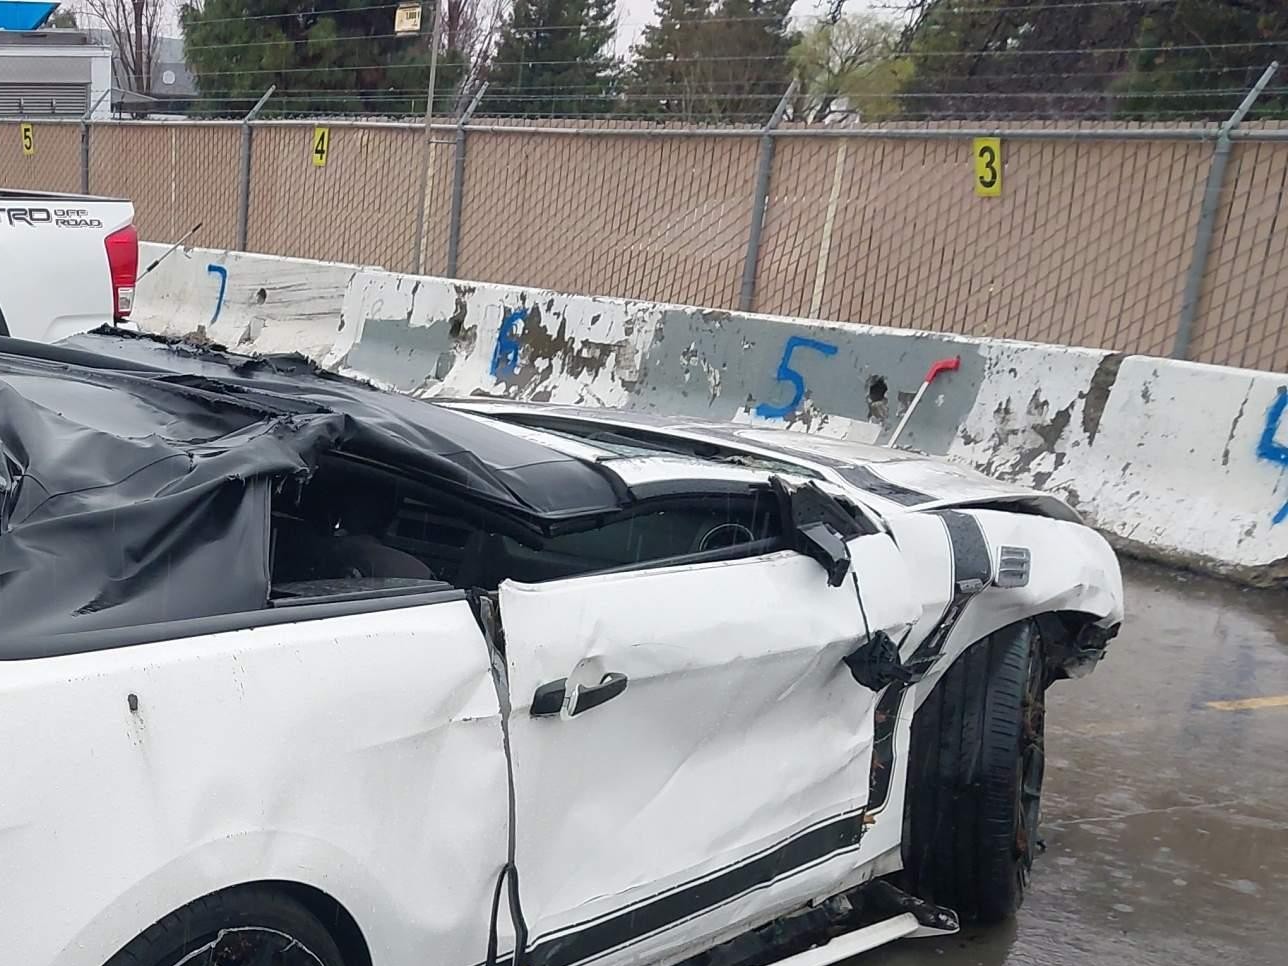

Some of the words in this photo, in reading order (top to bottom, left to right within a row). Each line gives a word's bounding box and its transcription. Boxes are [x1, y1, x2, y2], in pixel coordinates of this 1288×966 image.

[23, 127, 32, 150] 5
[315, 131, 325, 160] 4
[979, 145, 997, 188] 3
[54, 208, 89, 218] OFF
[55, 218, 103, 228] ROAD
[208, 264, 227, 327] 7
[756, 336, 838, 418] 5
